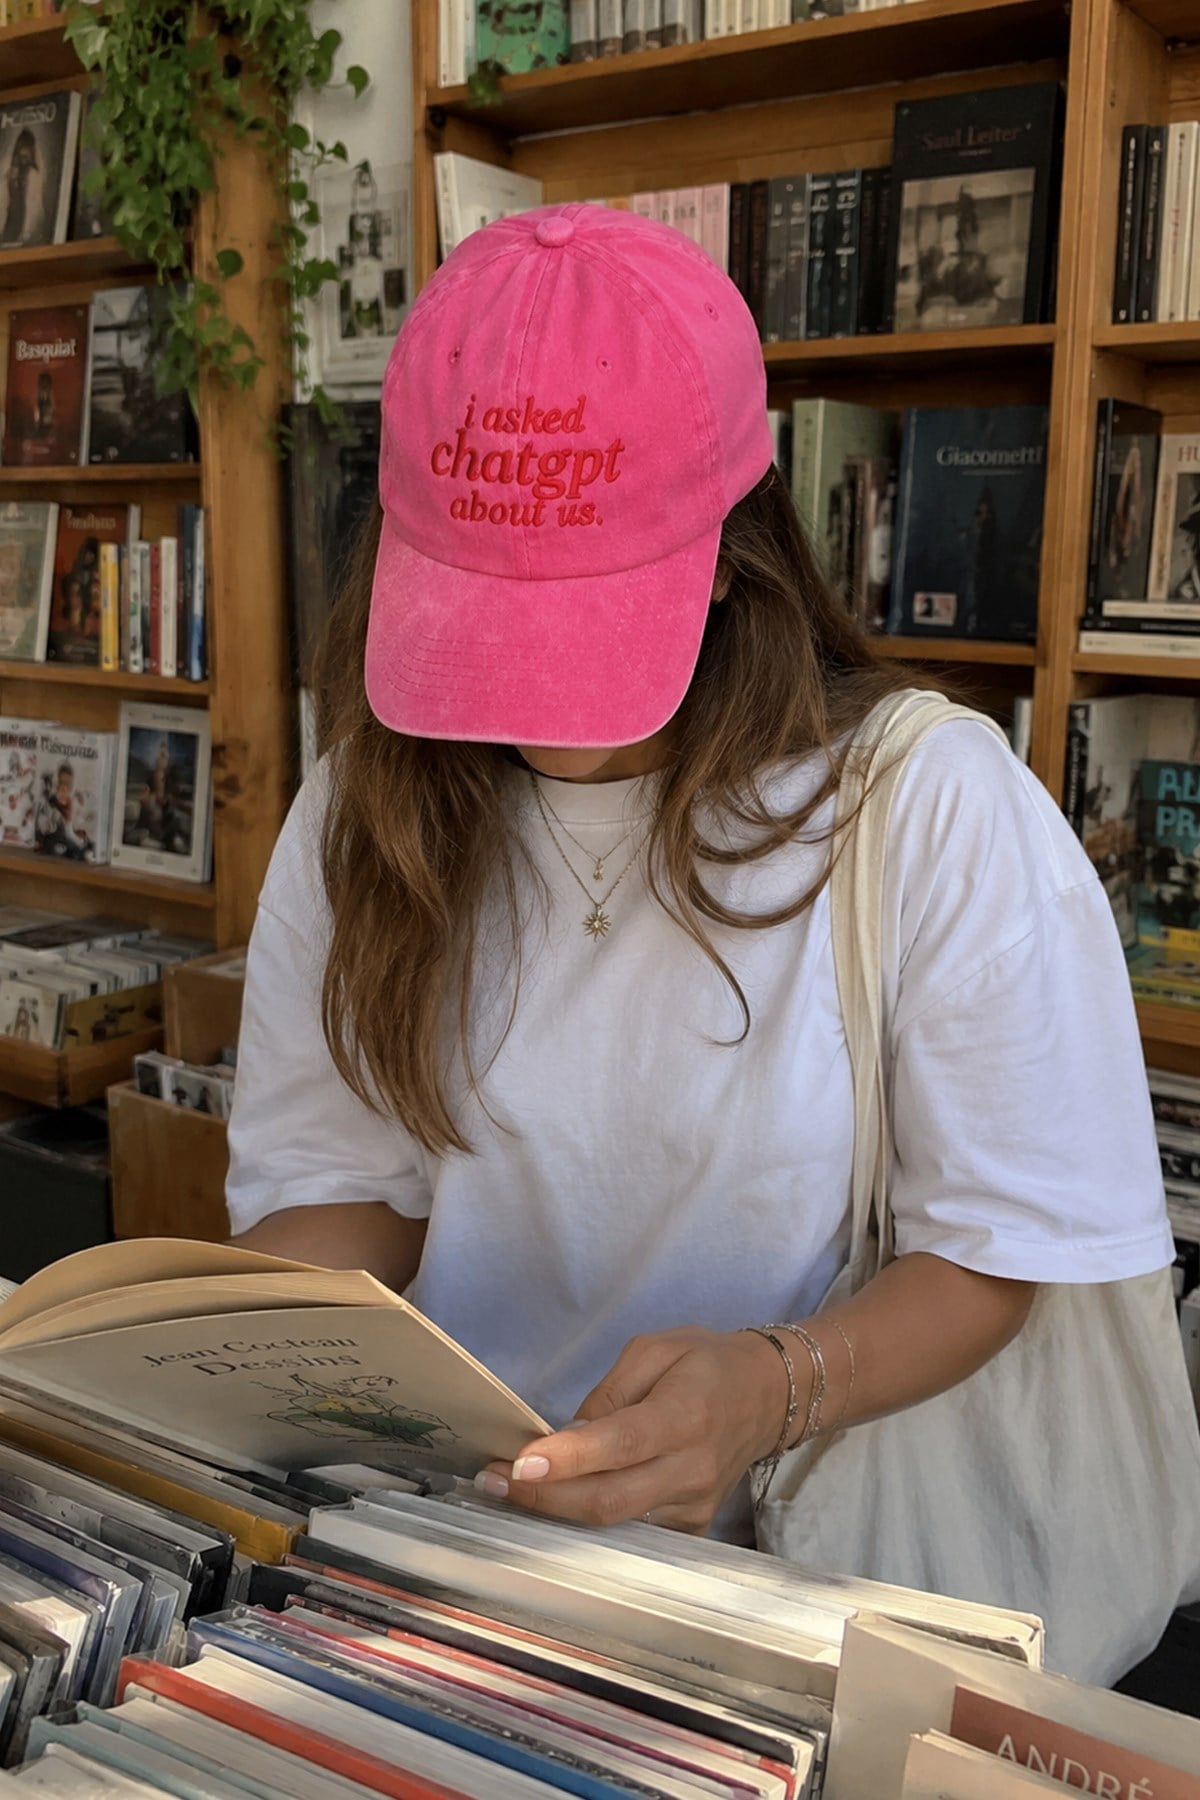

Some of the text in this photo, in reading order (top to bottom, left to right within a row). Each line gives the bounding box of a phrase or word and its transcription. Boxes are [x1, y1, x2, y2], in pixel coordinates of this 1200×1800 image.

[465, 394, 587, 434] i asked
[430, 427, 626, 501] chatgpt
[450, 489, 604, 528] about us.
[1156, 805, 1200, 837] PR
[141, 1337, 360, 1368] Jean Cocteau
[192, 1353, 361, 1376] Dessins
